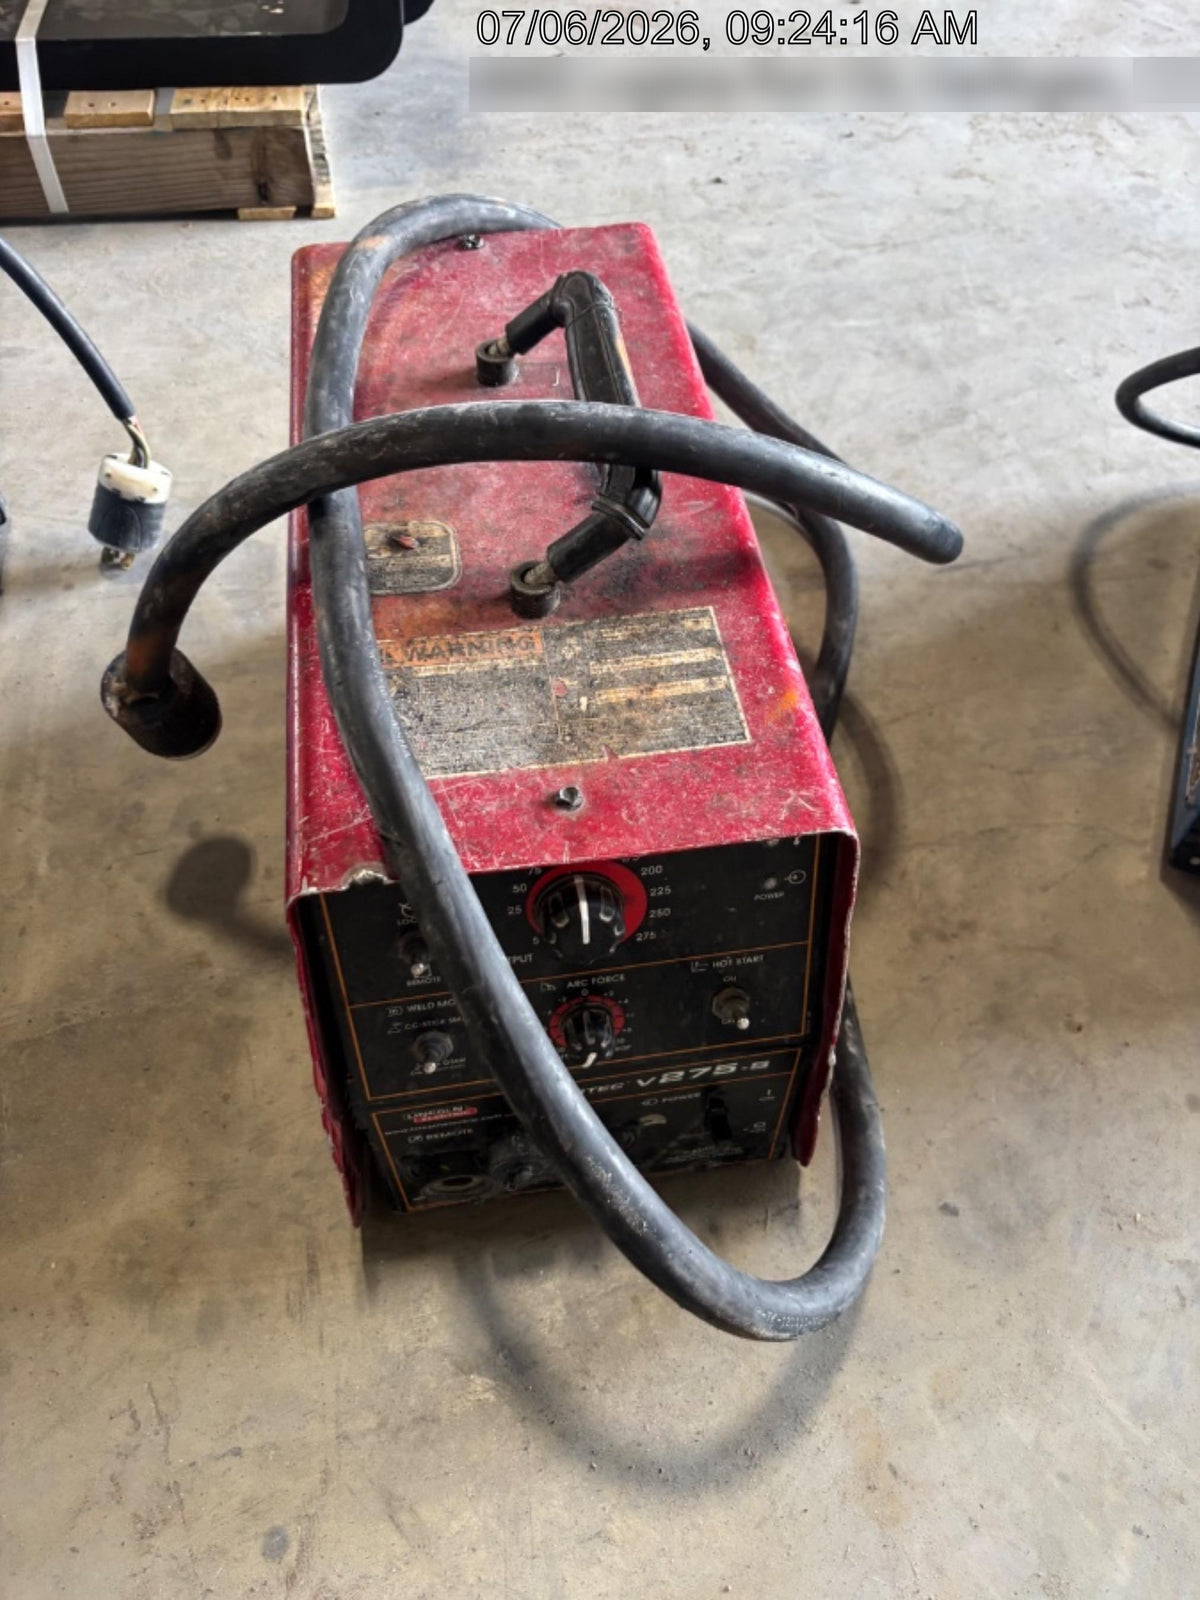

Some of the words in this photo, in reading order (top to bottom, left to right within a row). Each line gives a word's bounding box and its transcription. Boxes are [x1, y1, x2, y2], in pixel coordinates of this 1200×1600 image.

[406, 634, 536, 662] WARNING
[640, 865, 664, 875] 200
[512, 883, 528, 894] 50
[650, 886, 672, 897] 225
[753, 891, 785, 902] POWER
[506, 905, 522, 915] 25
[648, 908, 671, 918] 250
[635, 932, 657, 942] 275
[712, 959, 732, 969] HOT
[736, 954, 765, 966] START
[406, 975, 442, 987] REMOTE
[566, 978, 590, 989] ARC
[591, 973, 627, 986] FORCE
[406, 1001, 435, 1013] WELD
[437, 998, 457, 1009] MO
[636, 1059, 770, 1088] V275-S
